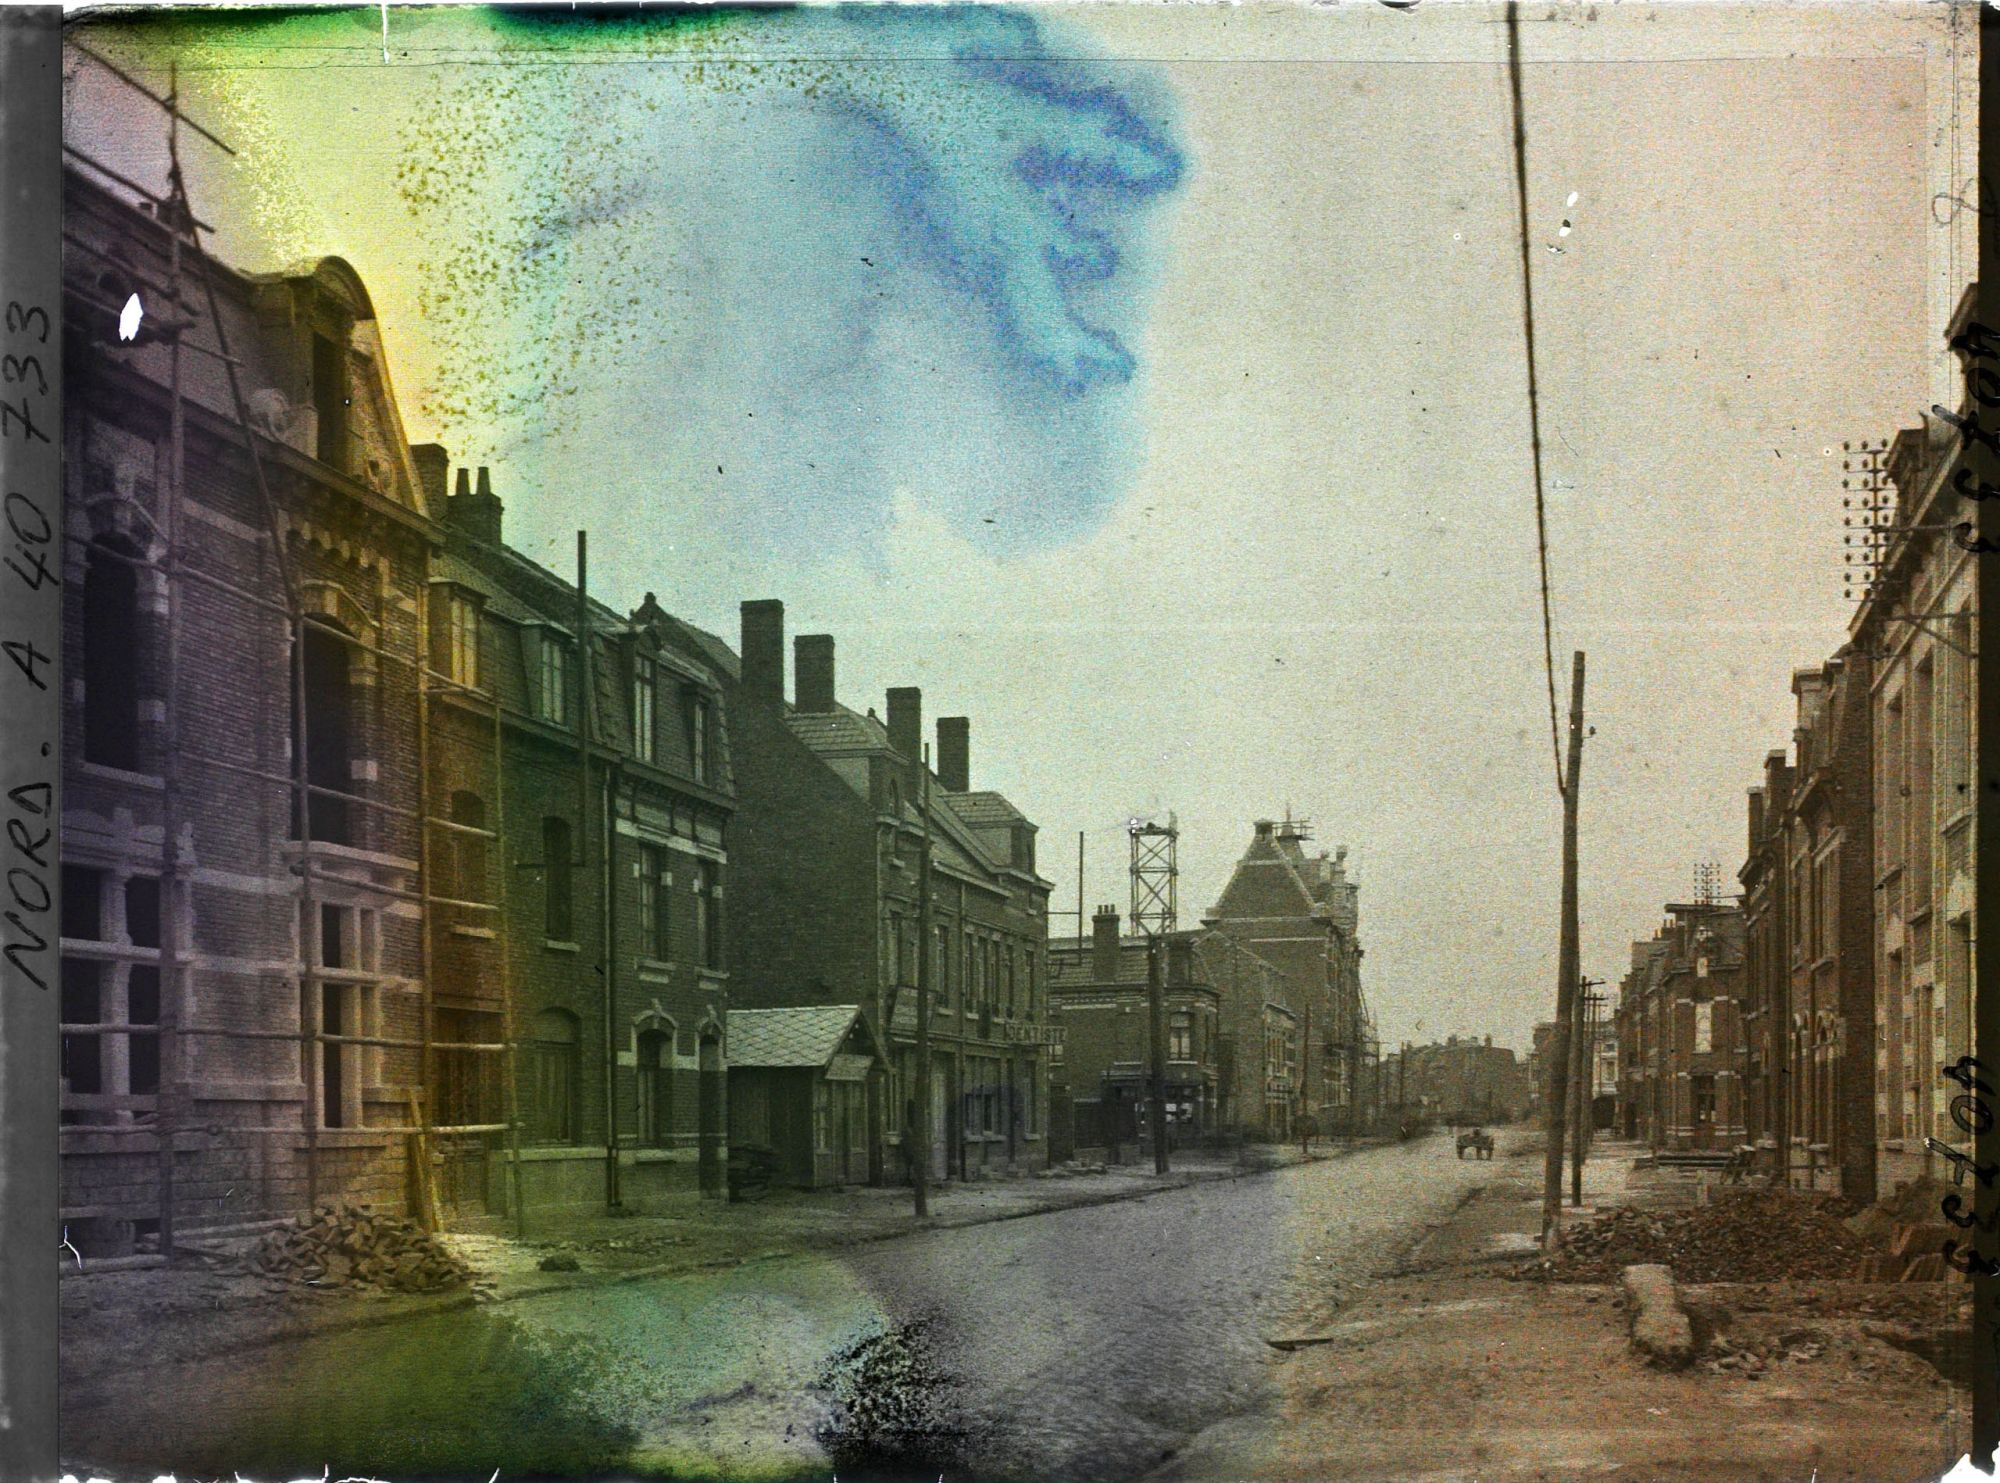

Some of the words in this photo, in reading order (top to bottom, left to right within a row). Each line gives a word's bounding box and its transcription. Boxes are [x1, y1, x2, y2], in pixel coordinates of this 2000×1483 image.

[2, 300, 50, 446] 733
[4, 492, 59, 592] 40
[2, 641, 50, 691] A
